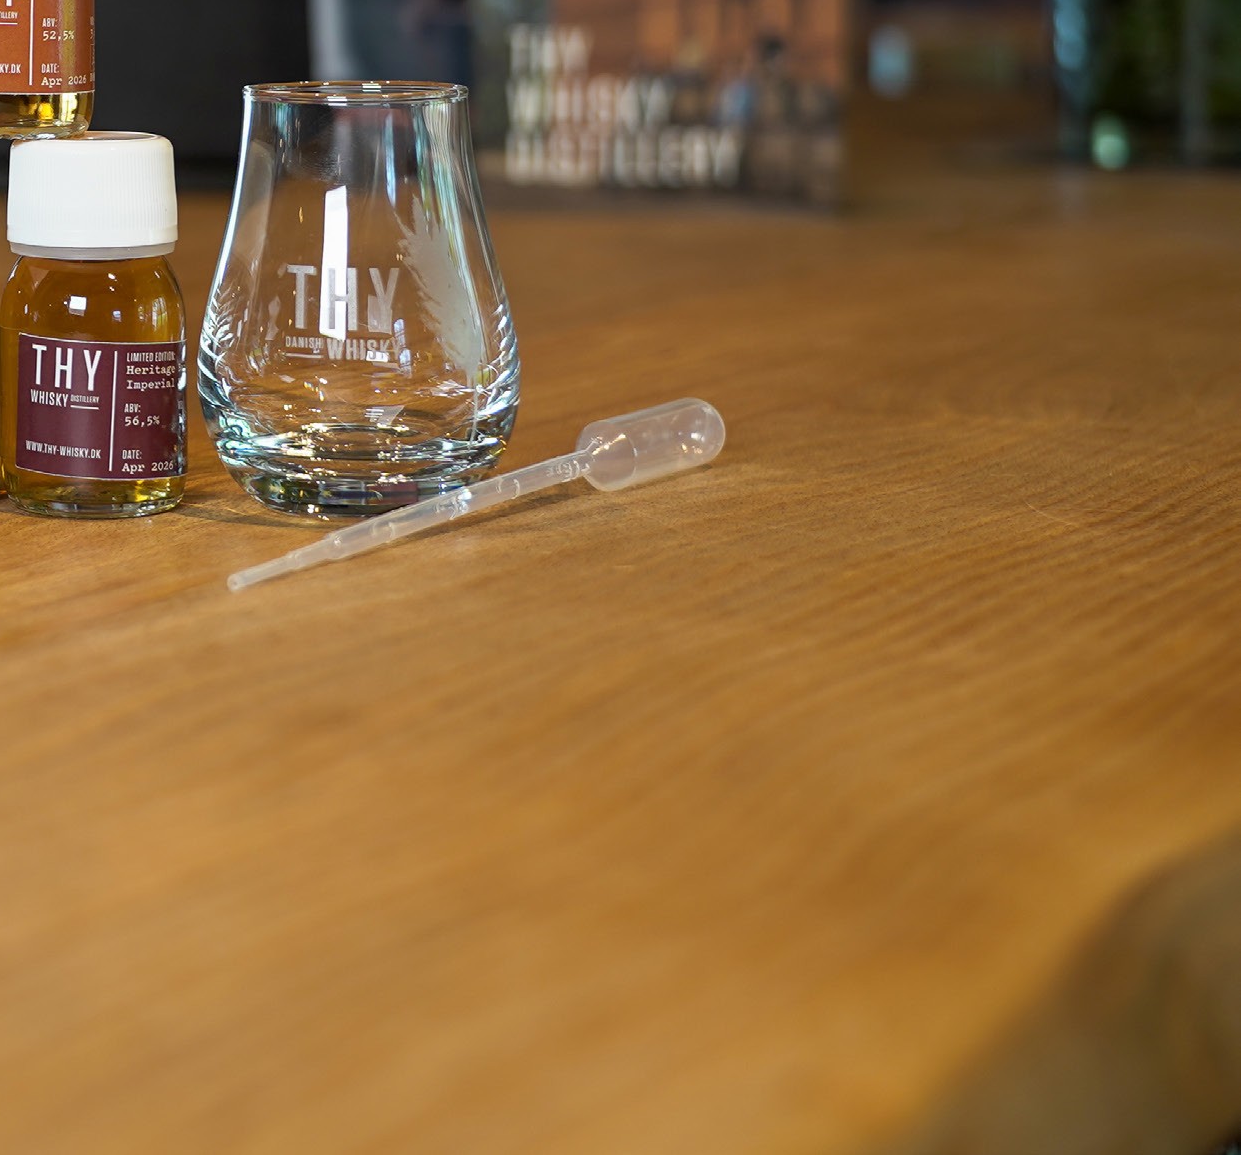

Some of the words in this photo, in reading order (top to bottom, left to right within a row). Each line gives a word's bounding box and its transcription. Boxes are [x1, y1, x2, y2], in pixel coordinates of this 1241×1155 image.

[42, 18, 57, 28] ABV:
[43, 30, 75, 42] 52,5%
[41, 63, 60, 74] DATE:
[41, 78, 62, 88] Apr
[68, 76, 87, 85] 2026
[287, 264, 400, 332] THY
[285, 336, 323, 349] DANISH
[326, 338, 401, 360] WHISKY
[126, 352, 154, 362] LIMITED
[31, 343, 102, 392] THY
[126, 364, 176, 376] Heritage
[126, 378, 175, 392] Imperial
[30, 389, 69, 408] WHISKY
[70, 394, 100, 403] DISTILLERY
[124, 403, 141, 413] ABV:
[124, 415, 160, 428] 56,5%
[25, 440, 102, 459] WWW.THY-WHISKY.DK
[122, 449, 142, 460] DATE:
[122, 462, 145, 475] Apr
[151, 460, 174, 472] 2026
